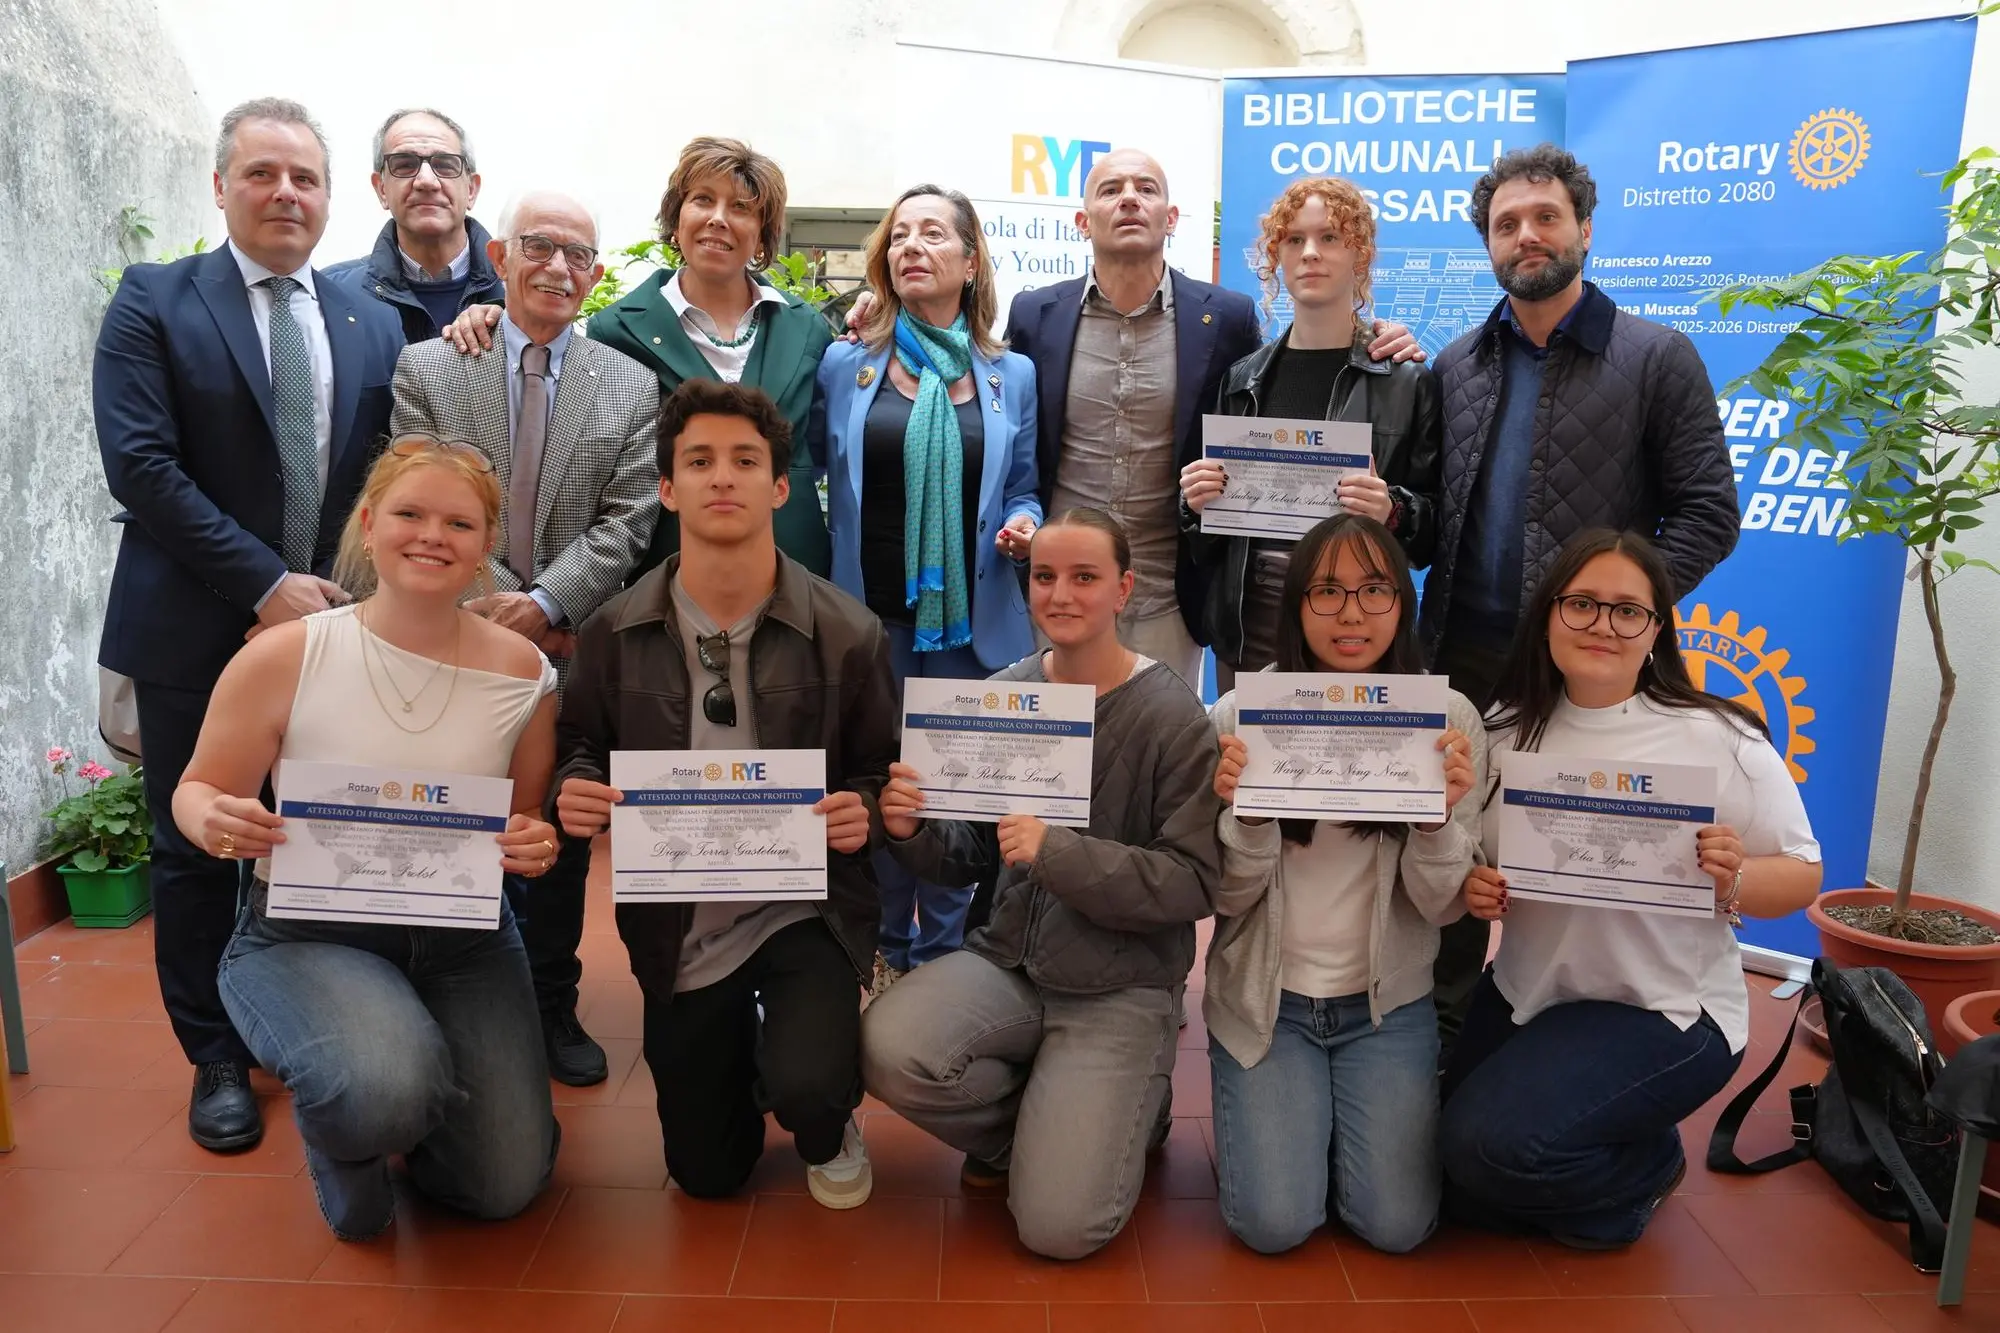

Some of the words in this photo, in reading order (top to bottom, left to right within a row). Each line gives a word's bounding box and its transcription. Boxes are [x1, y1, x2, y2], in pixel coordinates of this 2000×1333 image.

[1243, 89, 1537, 127] BIBLIOTECHE
[1658, 141, 1780, 175] Rotary
[1623, 184, 1711, 208] Distretto
[1718, 180, 1776, 204] 2080
[1360, 189, 1473, 222] SSAR
[1025, 216, 1045, 240] di
[1012, 250, 1075, 275] Youth
[1591, 256, 1660, 269] Francesco
[1662, 254, 1712, 267] Arezzo
[1590, 275, 1658, 288] Presidente
[1660, 273, 1734, 287] 2025-2026
[1644, 303, 1698, 316] Muscas
[1249, 430, 1272, 440] Rotary
[1295, 429, 1323, 446] RYE
[1758, 447, 1850, 490] DEL
[1677, 631, 1750, 663] TARY
[955, 694, 982, 705] Rotary
[1008, 693, 1039, 711] RYE
[1295, 688, 1325, 699] Rotary
[1354, 685, 1388, 704] RYE
[924, 718, 961, 726] ATTESTATO
[973, 720, 1014, 728] FREQUENZA
[1034, 723, 1072, 731] PROFITTO
[1261, 713, 1304, 721] ATTESTATO
[1316, 714, 1362, 722] FREQUENZA
[672, 767, 702, 778] Rotary
[731, 762, 767, 781] RYE
[930, 763, 968, 778] Naomi
[1272, 759, 1305, 778] Wang
[1374, 761, 1409, 776] Nina
[1557, 772, 1587, 784] Rotary
[1617, 772, 1653, 794] RYE
[347, 782, 380, 795] Rotary
[411, 782, 449, 804] RYE
[638, 793, 681, 801] ATTESTATO
[682, 793, 692, 801] DI
[694, 793, 741, 802] FREQUENZA
[742, 792, 761, 800] CON
[763, 792, 803, 800] PROFITTO
[1524, 794, 1565, 805] ATTESTATO
[1578, 800, 1625, 811] FREQUENZA
[1626, 804, 1646, 812] CON
[1648, 806, 1690, 816] PROFITTO
[306, 806, 354, 817] ATTESTATO
[356, 809, 366, 817] DI
[368, 811, 418, 821] FREQUENZA
[420, 814, 440, 822] CON
[442, 816, 484, 826] PROFITTO
[650, 841, 688, 862] Diego
[690, 841, 730, 857] Torres
[343, 860, 387, 876] Anna
